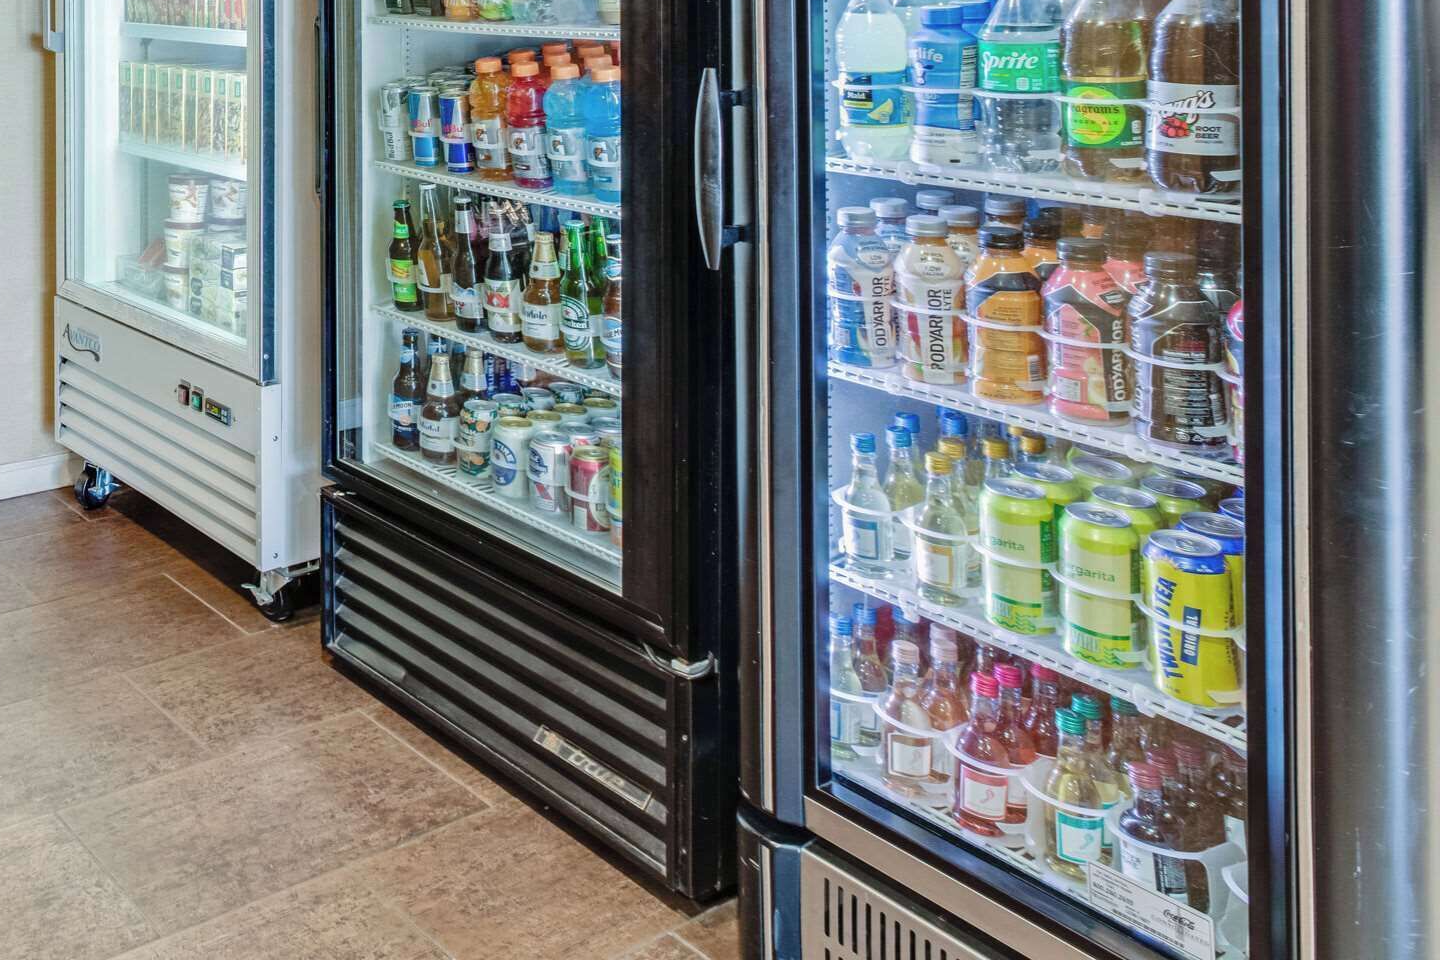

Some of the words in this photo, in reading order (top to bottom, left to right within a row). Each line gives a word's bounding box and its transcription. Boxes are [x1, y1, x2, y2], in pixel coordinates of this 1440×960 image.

[981, 51, 1040, 72] Sprite
[1073, 103, 1120, 117] agram's
[943, 288, 953, 311] LYTE
[871, 276, 888, 347] ODYARMOR
[1073, 564, 1116, 583] garita
